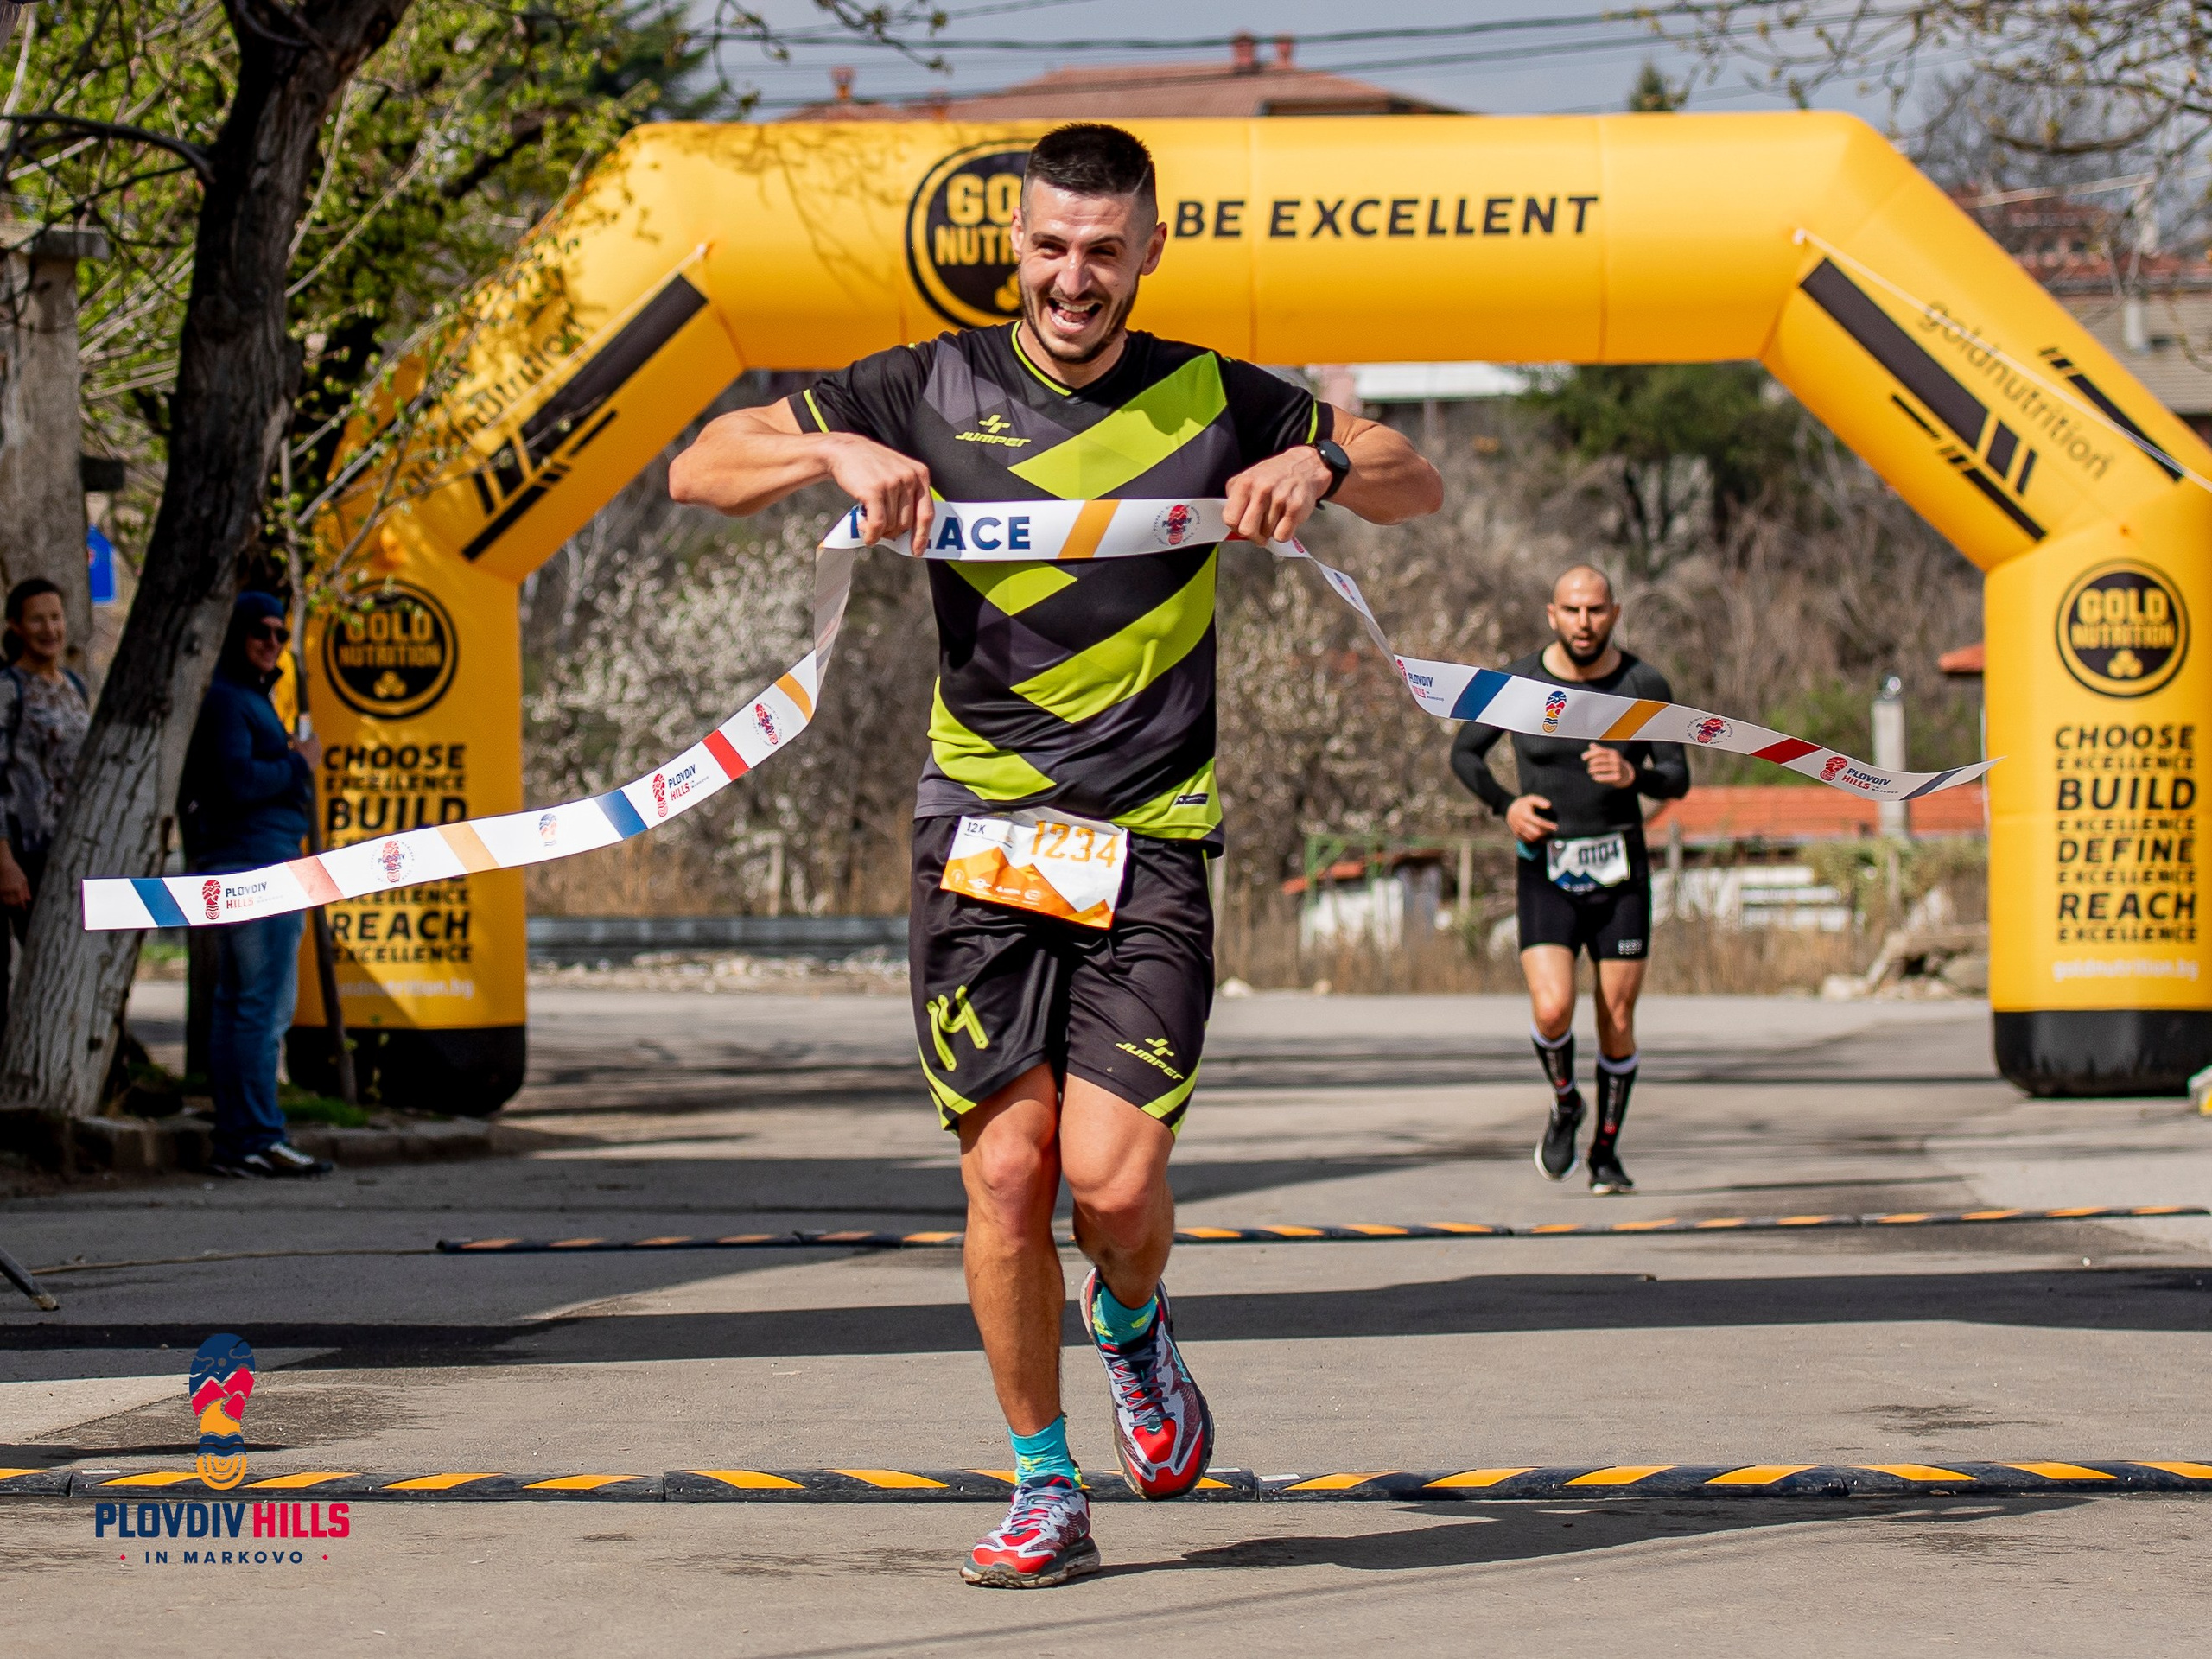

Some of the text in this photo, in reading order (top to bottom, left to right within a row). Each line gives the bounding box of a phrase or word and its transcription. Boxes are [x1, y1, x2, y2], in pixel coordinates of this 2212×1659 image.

[947, 172, 1023, 226] GO
[1174, 196, 1598, 238] BE EXCELLENT
[1916, 301, 2114, 480] goldnutrition
[2078, 588, 2169, 625] GOLD
[2070, 623, 2176, 649] NUTRITION
[2055, 724, 2195, 750] CHOOSE
[324, 744, 466, 770] CHOOSE
[2056, 756, 2194, 771] EXCELLENCE
[668, 764, 696, 789] PLOVDIV
[1841, 775, 1871, 790] HILLS
[1847, 768, 1891, 785] PLOVDIV
[671, 782, 690, 801] HILLS
[2057, 777, 2196, 810] BUILD
[966, 822, 986, 835] 12K
[2056, 817, 2195, 832] EXCELLENCE
[1031, 820, 1119, 868] 1234
[2058, 838, 2196, 864] DEFINE
[226, 881, 267, 898] PLOVDIV
[2058, 868, 2196, 885] EXCELLENCE
[226, 897, 254, 909] HILLS
[2058, 892, 2196, 920] REACH
[332, 910, 470, 942] REACH
[2058, 926, 2196, 943] EXCELLENCE
